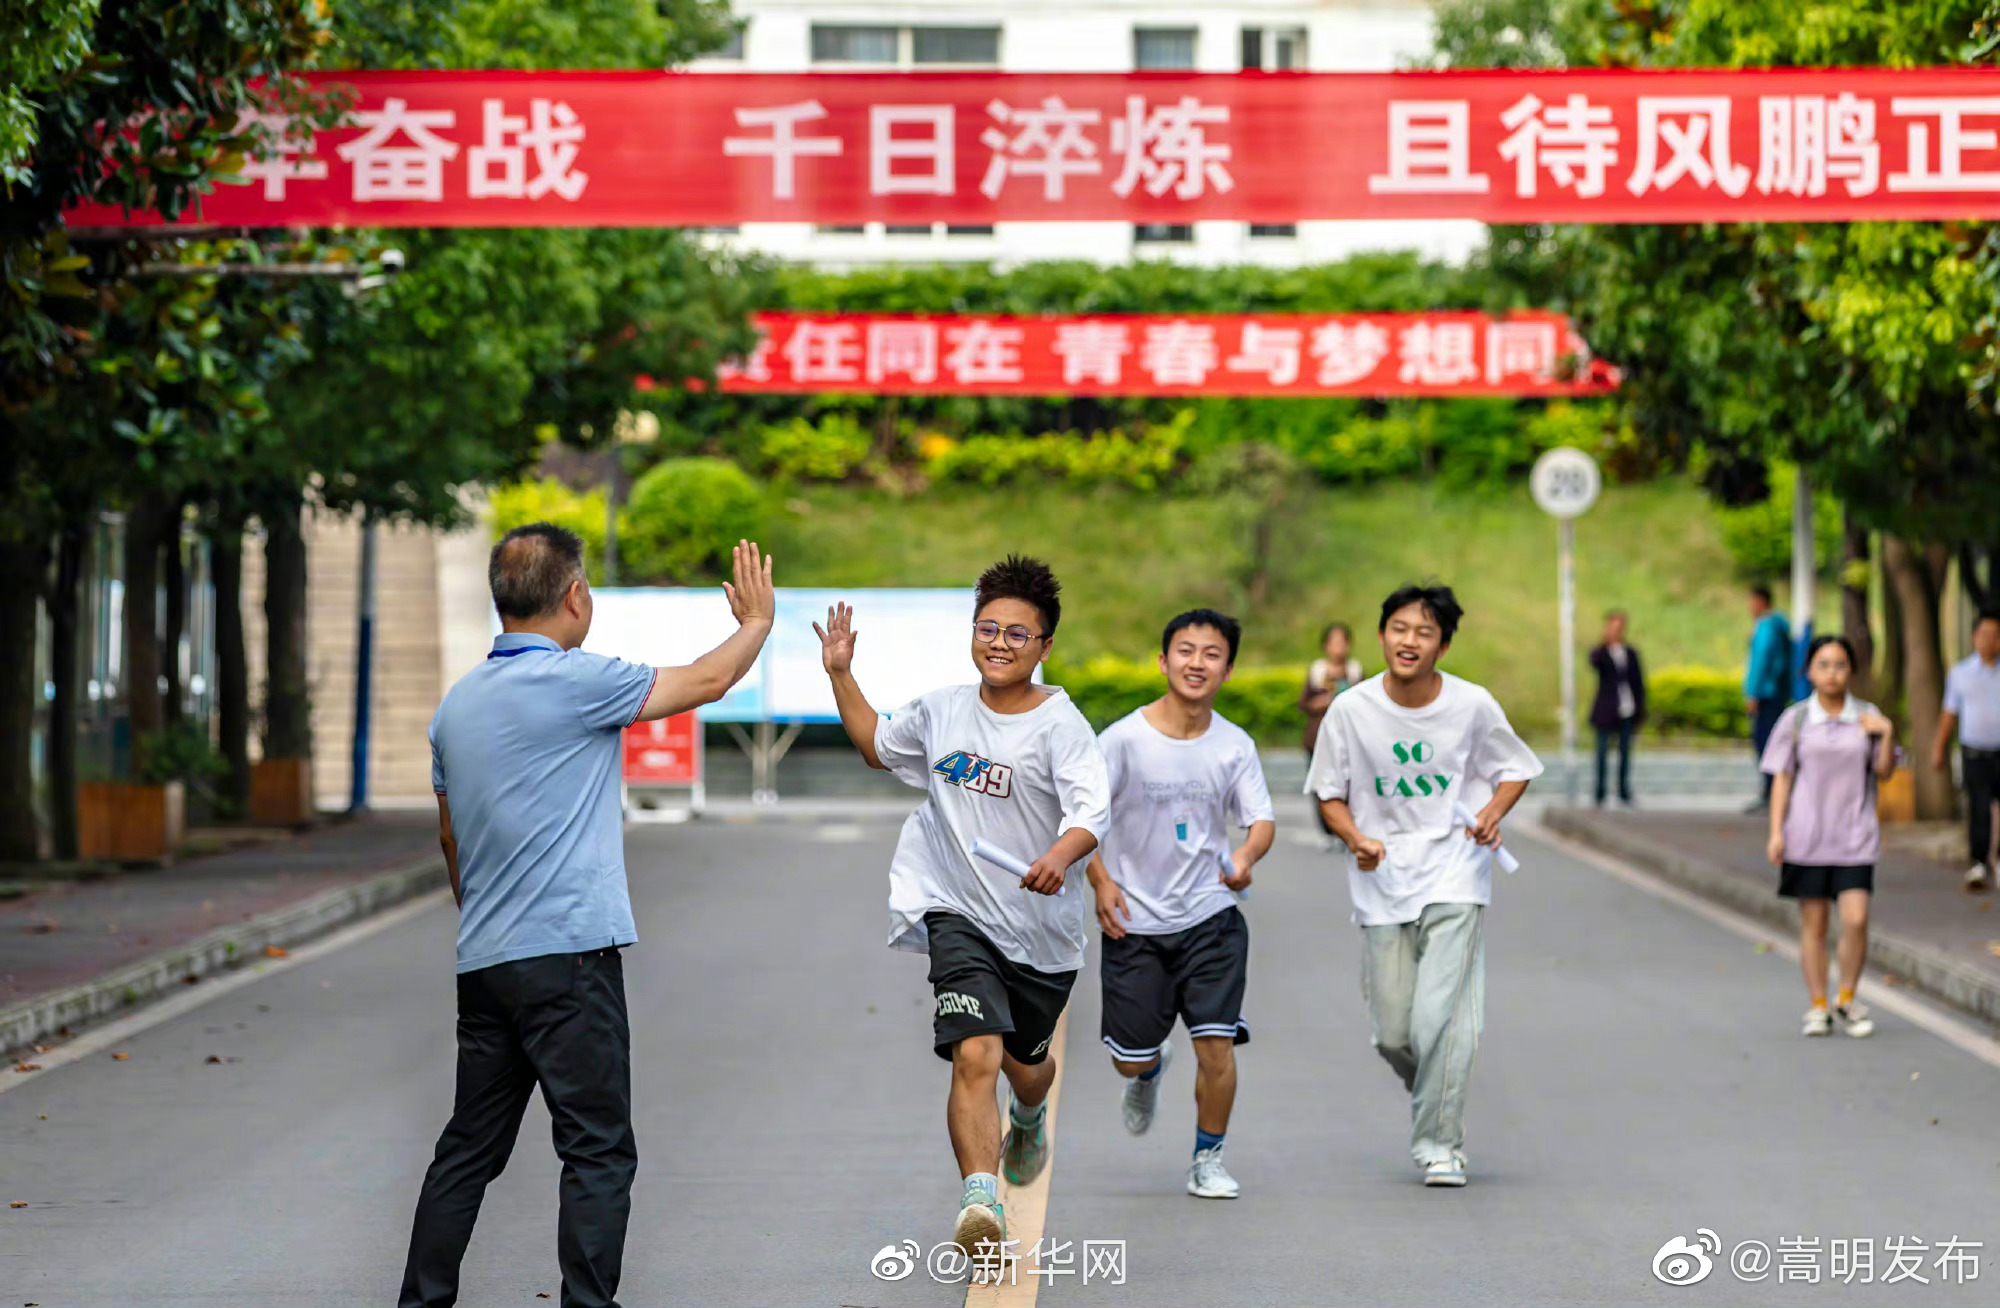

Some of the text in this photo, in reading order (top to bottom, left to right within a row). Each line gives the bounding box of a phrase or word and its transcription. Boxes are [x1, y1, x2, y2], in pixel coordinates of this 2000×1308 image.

[97, 92, 2000, 203] 年奋战 千日淬炼 且待风鹏正
[1392, 741, 1435, 765] SO
[1375, 774, 1454, 798] EASY
